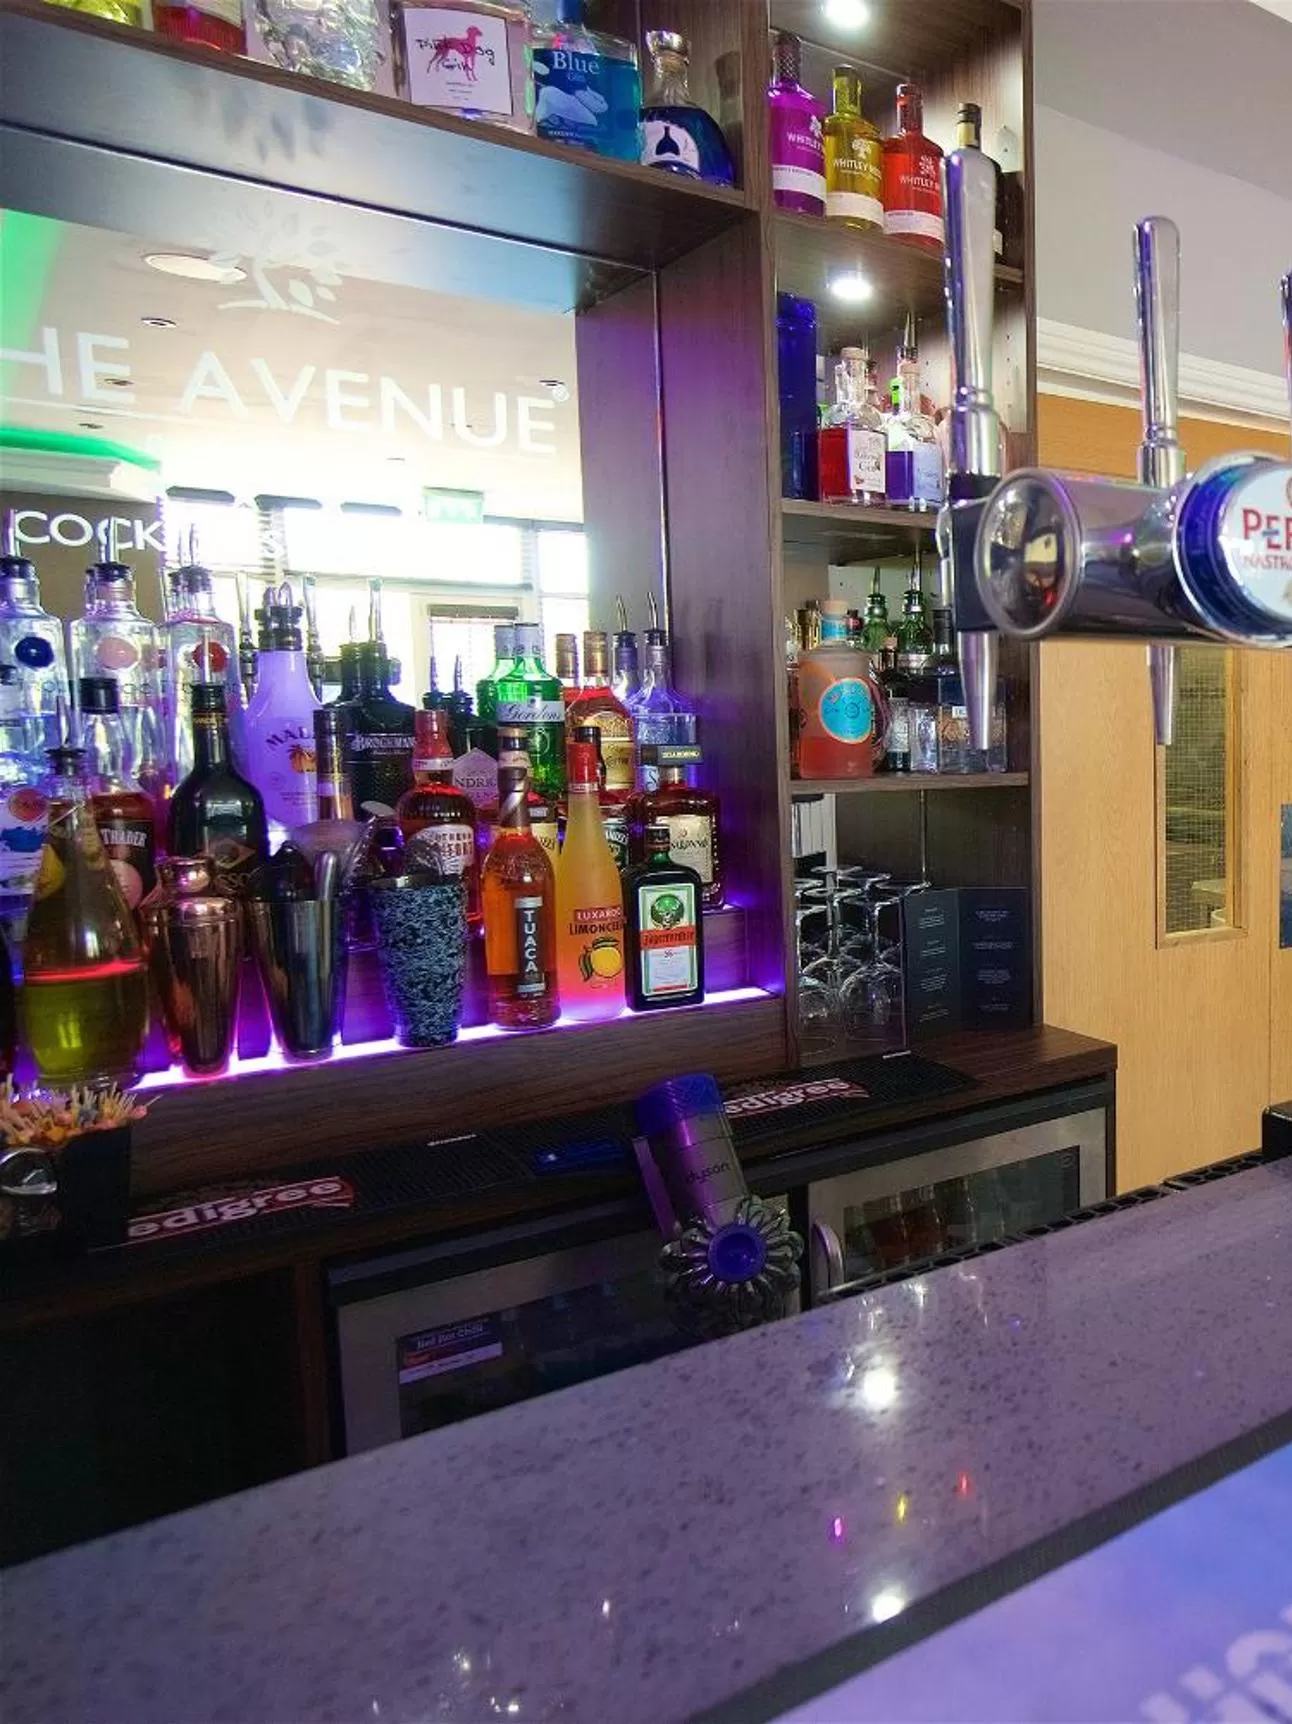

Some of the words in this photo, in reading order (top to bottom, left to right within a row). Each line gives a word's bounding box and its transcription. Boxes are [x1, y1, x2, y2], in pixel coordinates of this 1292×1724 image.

[552, 50, 600, 75] Blue
[832, 158, 868, 173] WHITLEY
[0, 326, 136, 404] HE
[180, 350, 558, 455] AVENUE
[351, 734, 418, 751] BROCKMAN
[523, 909, 539, 973] TUACA
[724, 1080, 850, 1116] edigree
[685, 1160, 730, 1186] dyson
[126, 1178, 346, 1240] edigree
